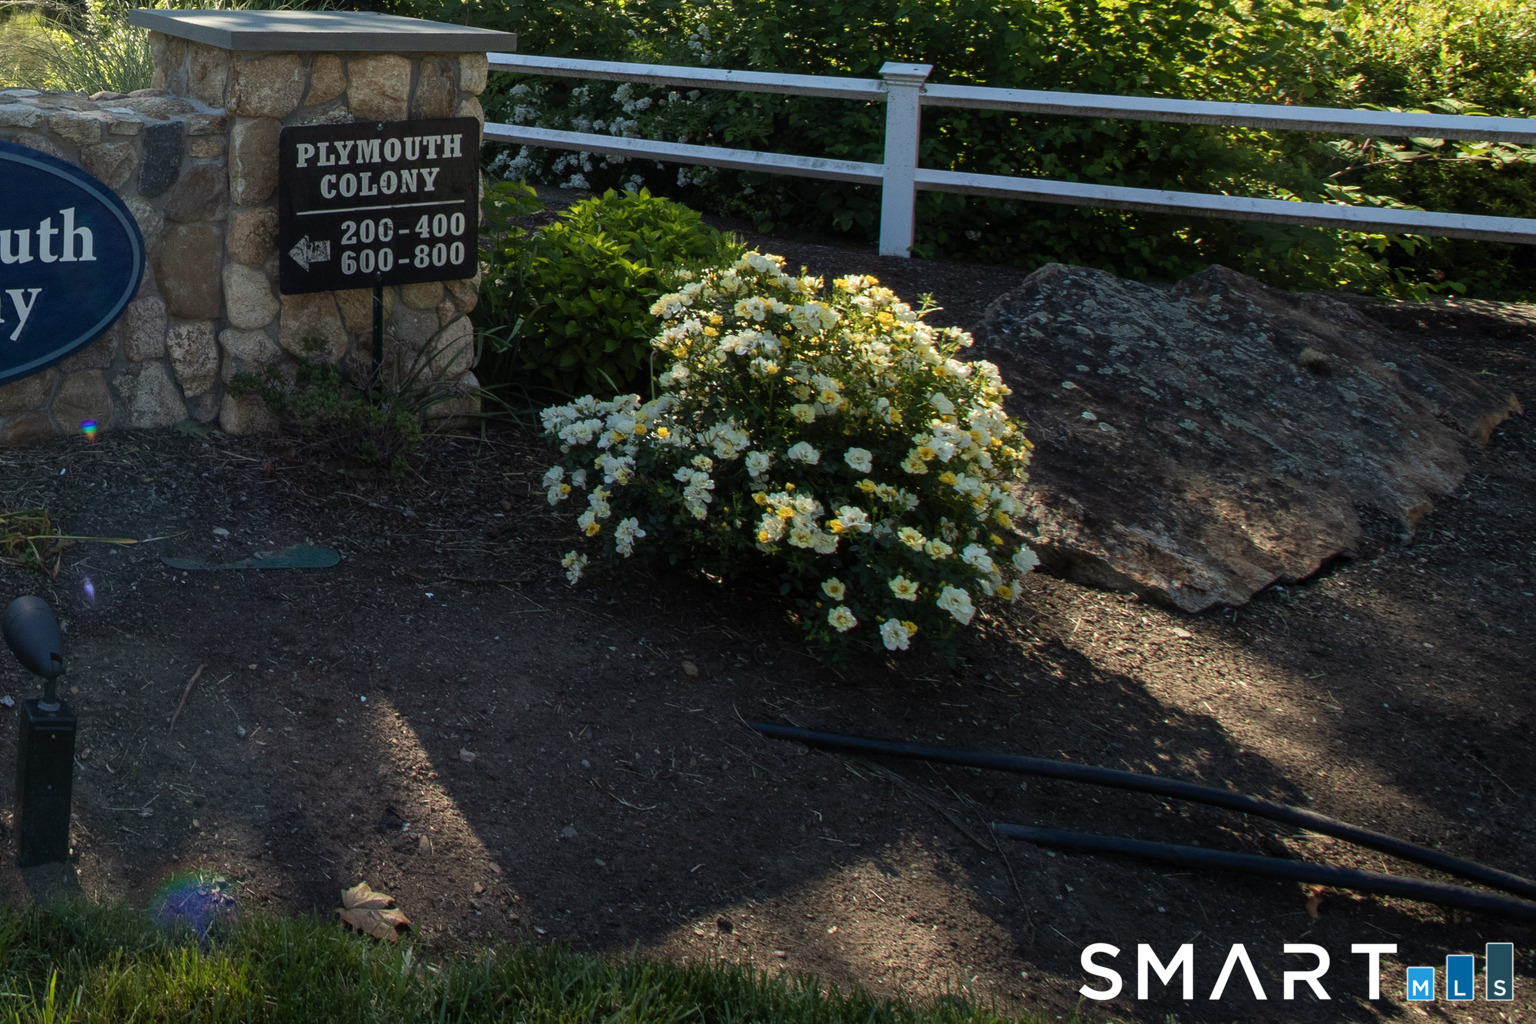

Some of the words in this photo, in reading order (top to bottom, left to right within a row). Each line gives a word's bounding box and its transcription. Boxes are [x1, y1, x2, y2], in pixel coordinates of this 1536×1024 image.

[296, 133, 463, 168] PLYMOUTH
[320, 167, 440, 199] COLONY
[340, 212, 465, 245] 200-400
[340, 241, 465, 275] 600-800
